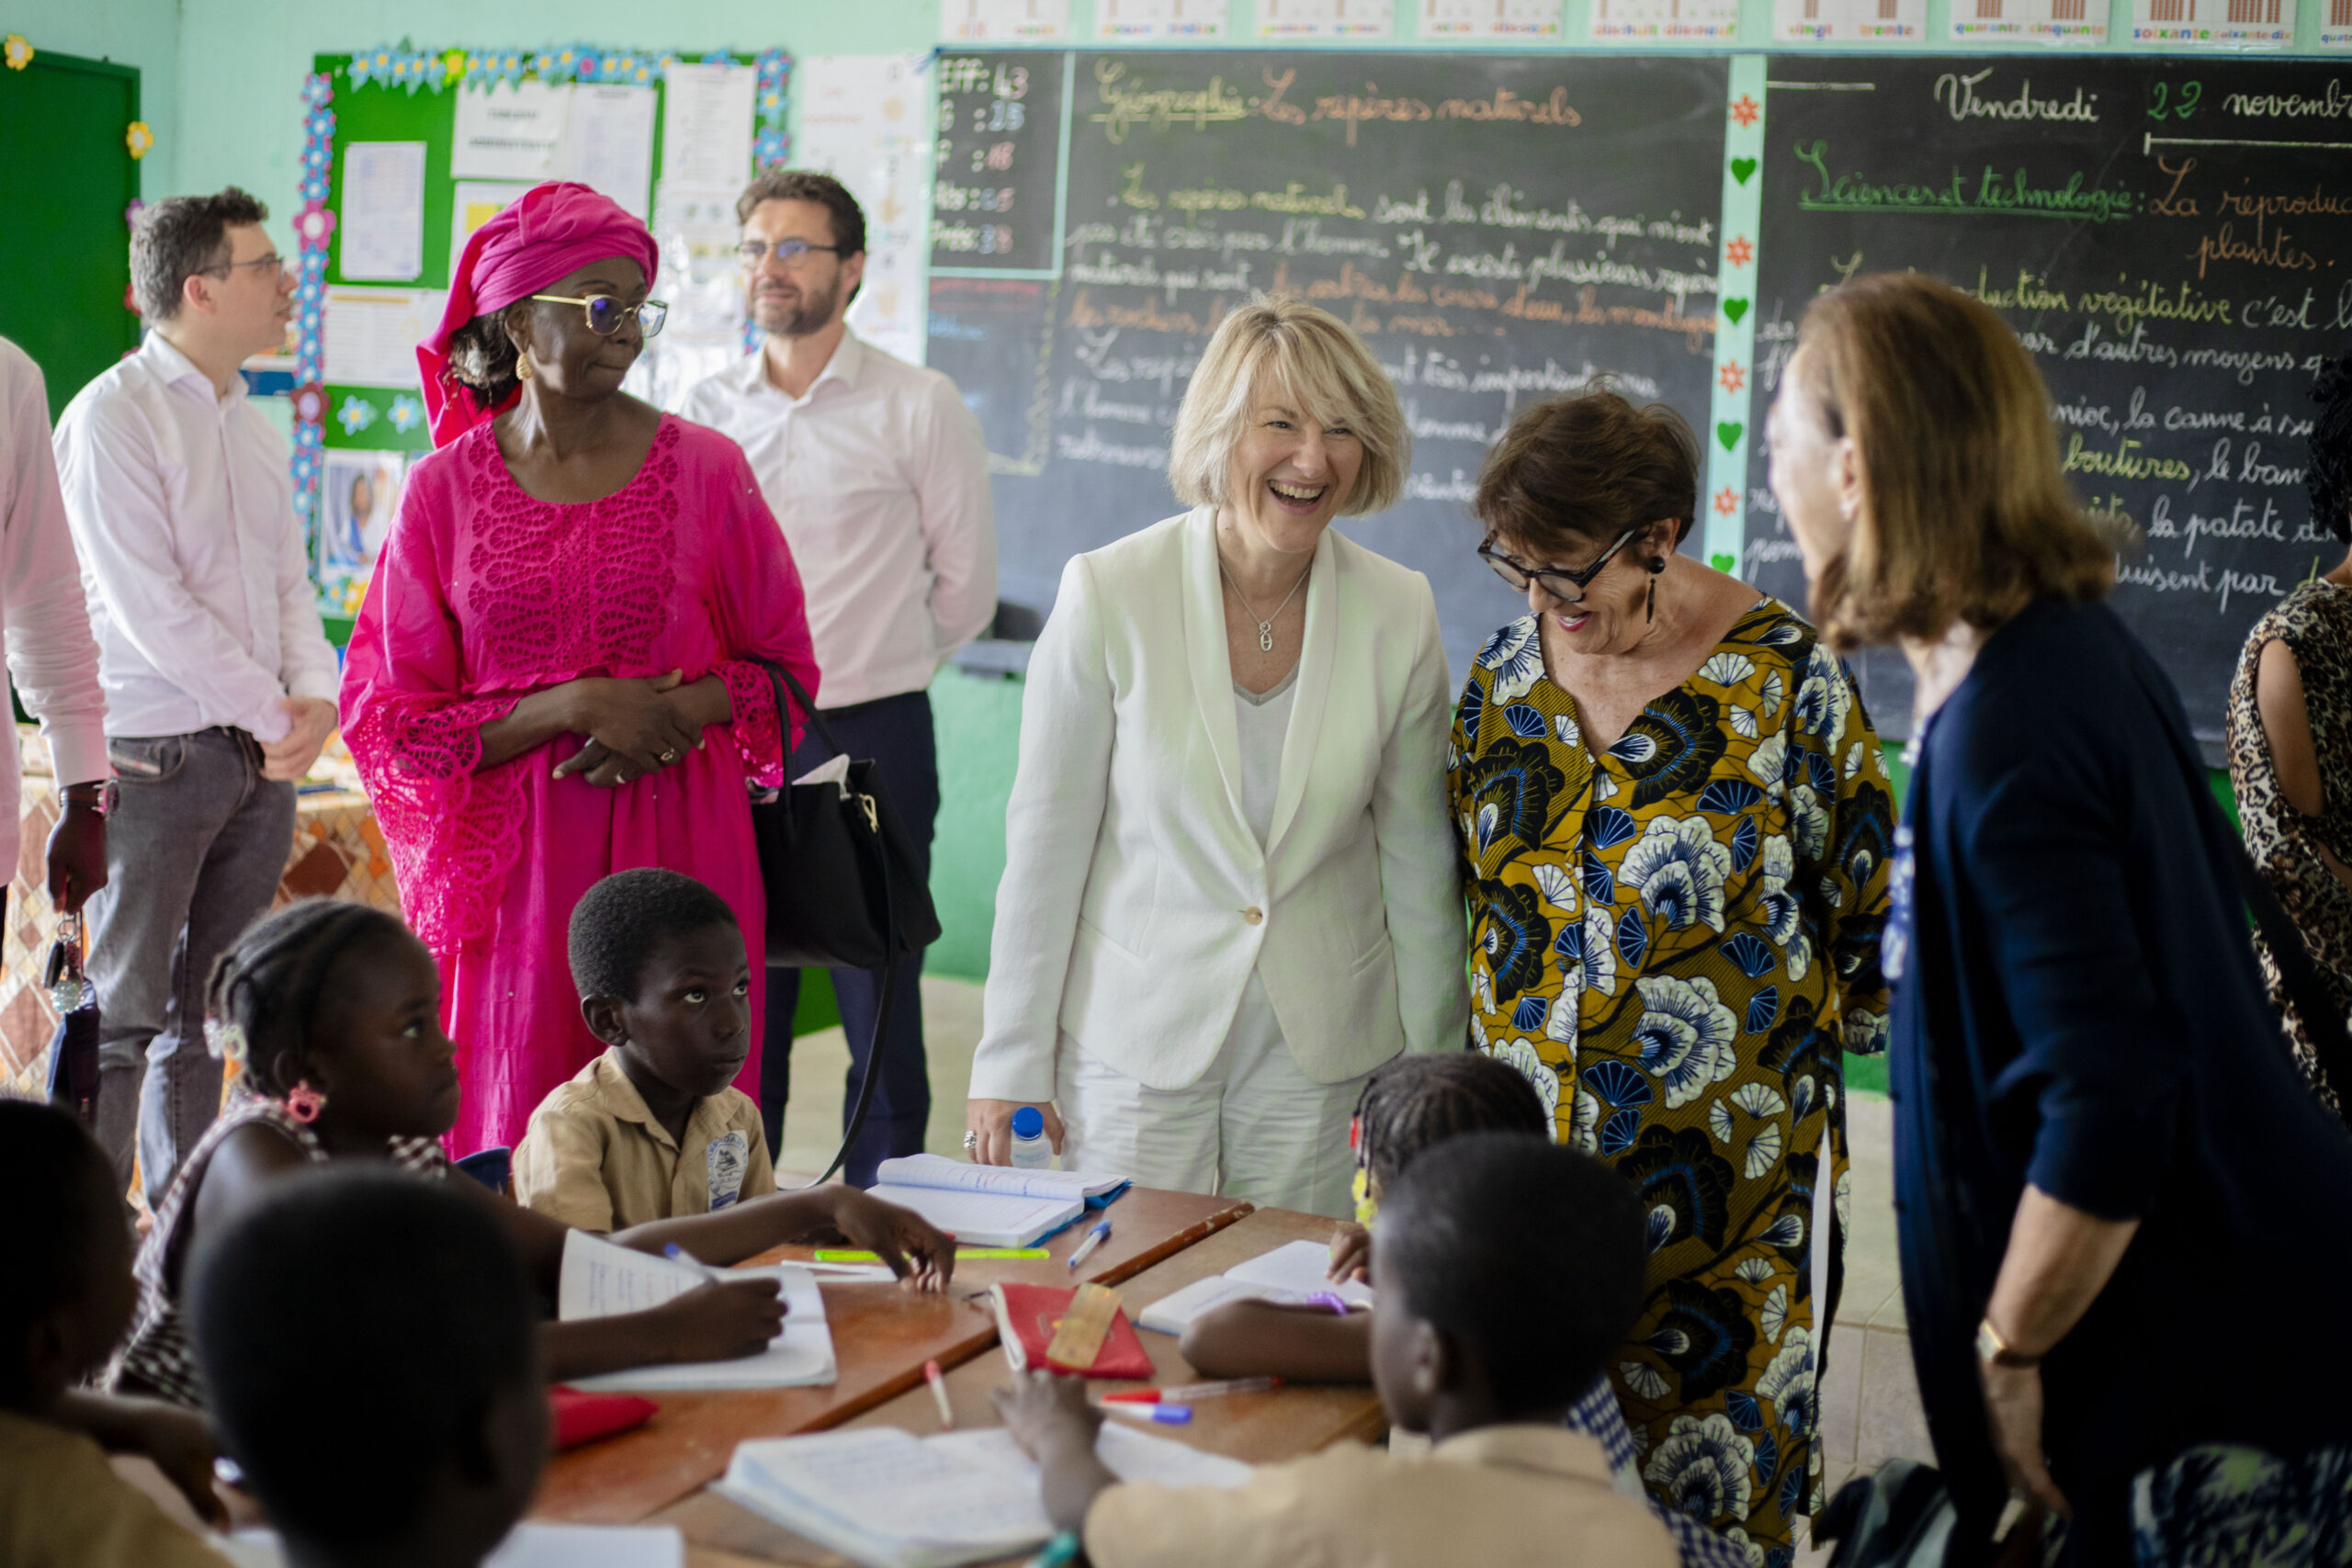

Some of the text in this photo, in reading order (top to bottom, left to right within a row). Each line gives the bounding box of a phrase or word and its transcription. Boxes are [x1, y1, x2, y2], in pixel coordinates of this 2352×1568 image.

[1788, 22, 1915, 39] vingt trente
[1954, 22, 2107, 37] quarante cinquante
[2133, 26, 2292, 40] soixante soixante-dix
[1311, 80, 1431, 147] repères
[1435, 85, 1582, 127] naturels
[1934, 66, 2100, 122] Vendredi
[2147, 80, 2201, 121] 22
[1792, 138, 1938, 208] Sciences
[1939, 165, 1968, 208] et
[2147, 154, 2201, 218] La
[1372, 189, 1435, 225] sont
[1525, 238, 1654, 293] plusieurs
[2076, 272, 2233, 337] végétative
[2241, 286, 2319, 329] c'est
[2064, 321, 2178, 367] d'autres
[2181, 348, 2296, 387] moyens
[2121, 384, 2157, 432] la
[2163, 405, 2245, 433] canne
[2248, 402, 2274, 434] à
[2204, 436, 2230, 482] le
[2146, 493, 2180, 539] la
[2183, 497, 2287, 559] patate
[2214, 568, 2287, 615] par
